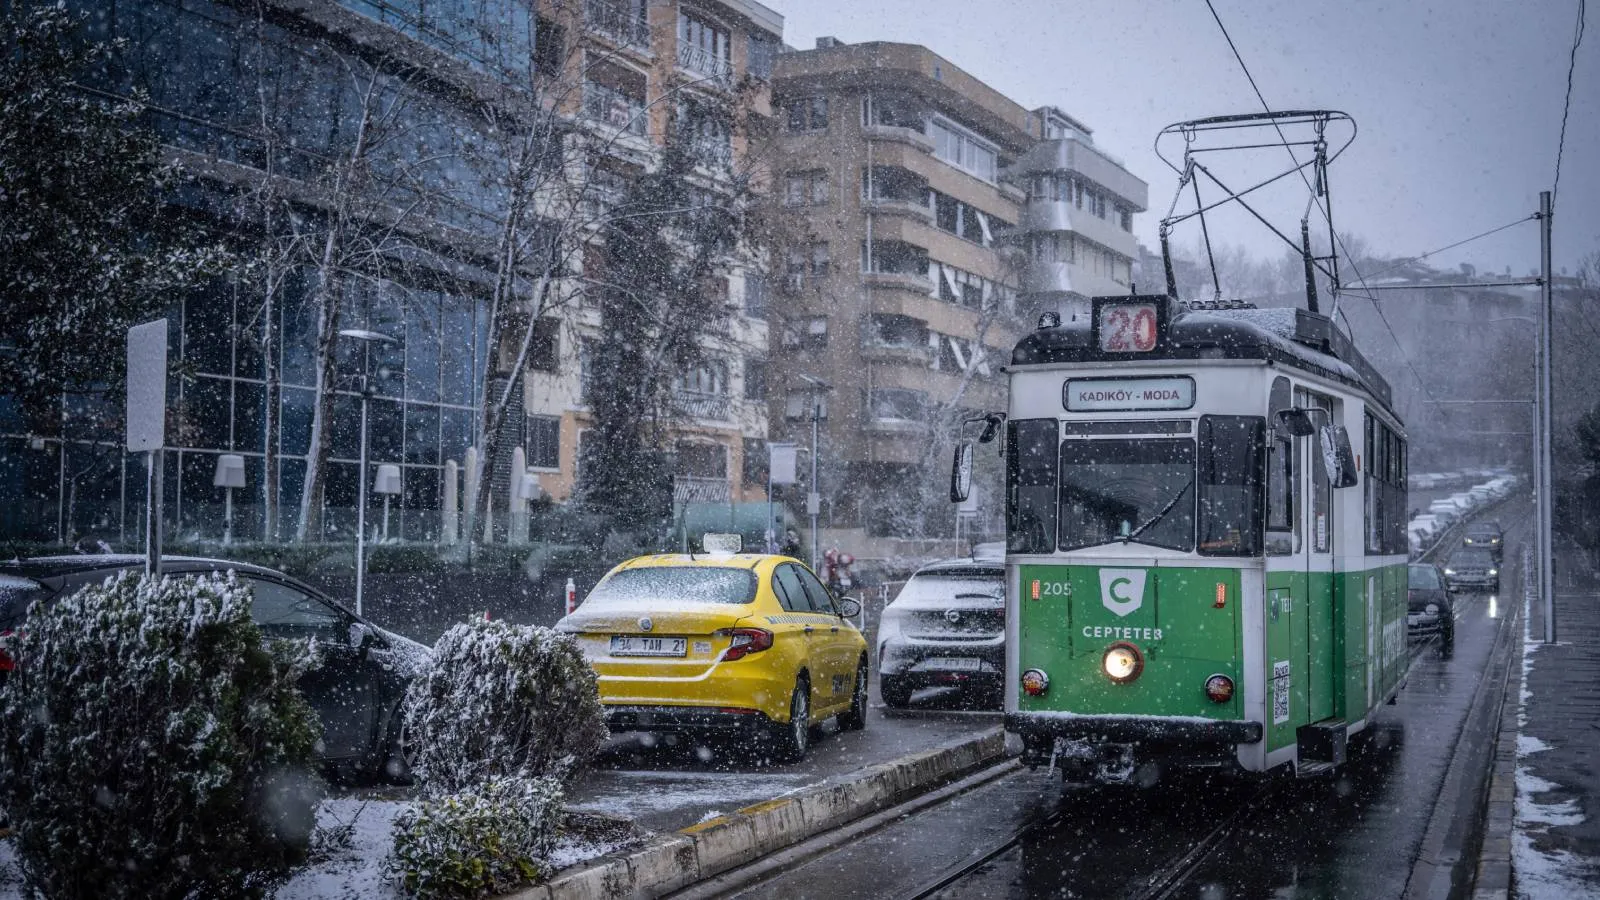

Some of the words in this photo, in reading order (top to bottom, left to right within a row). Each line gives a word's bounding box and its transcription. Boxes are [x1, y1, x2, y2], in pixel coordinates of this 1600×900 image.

[1107, 307, 1157, 350] 20
[1143, 390, 1180, 400] MODA
[1043, 582, 1072, 596] 205
[1109, 577, 1132, 604] C
[673, 639, 685, 652] 21
